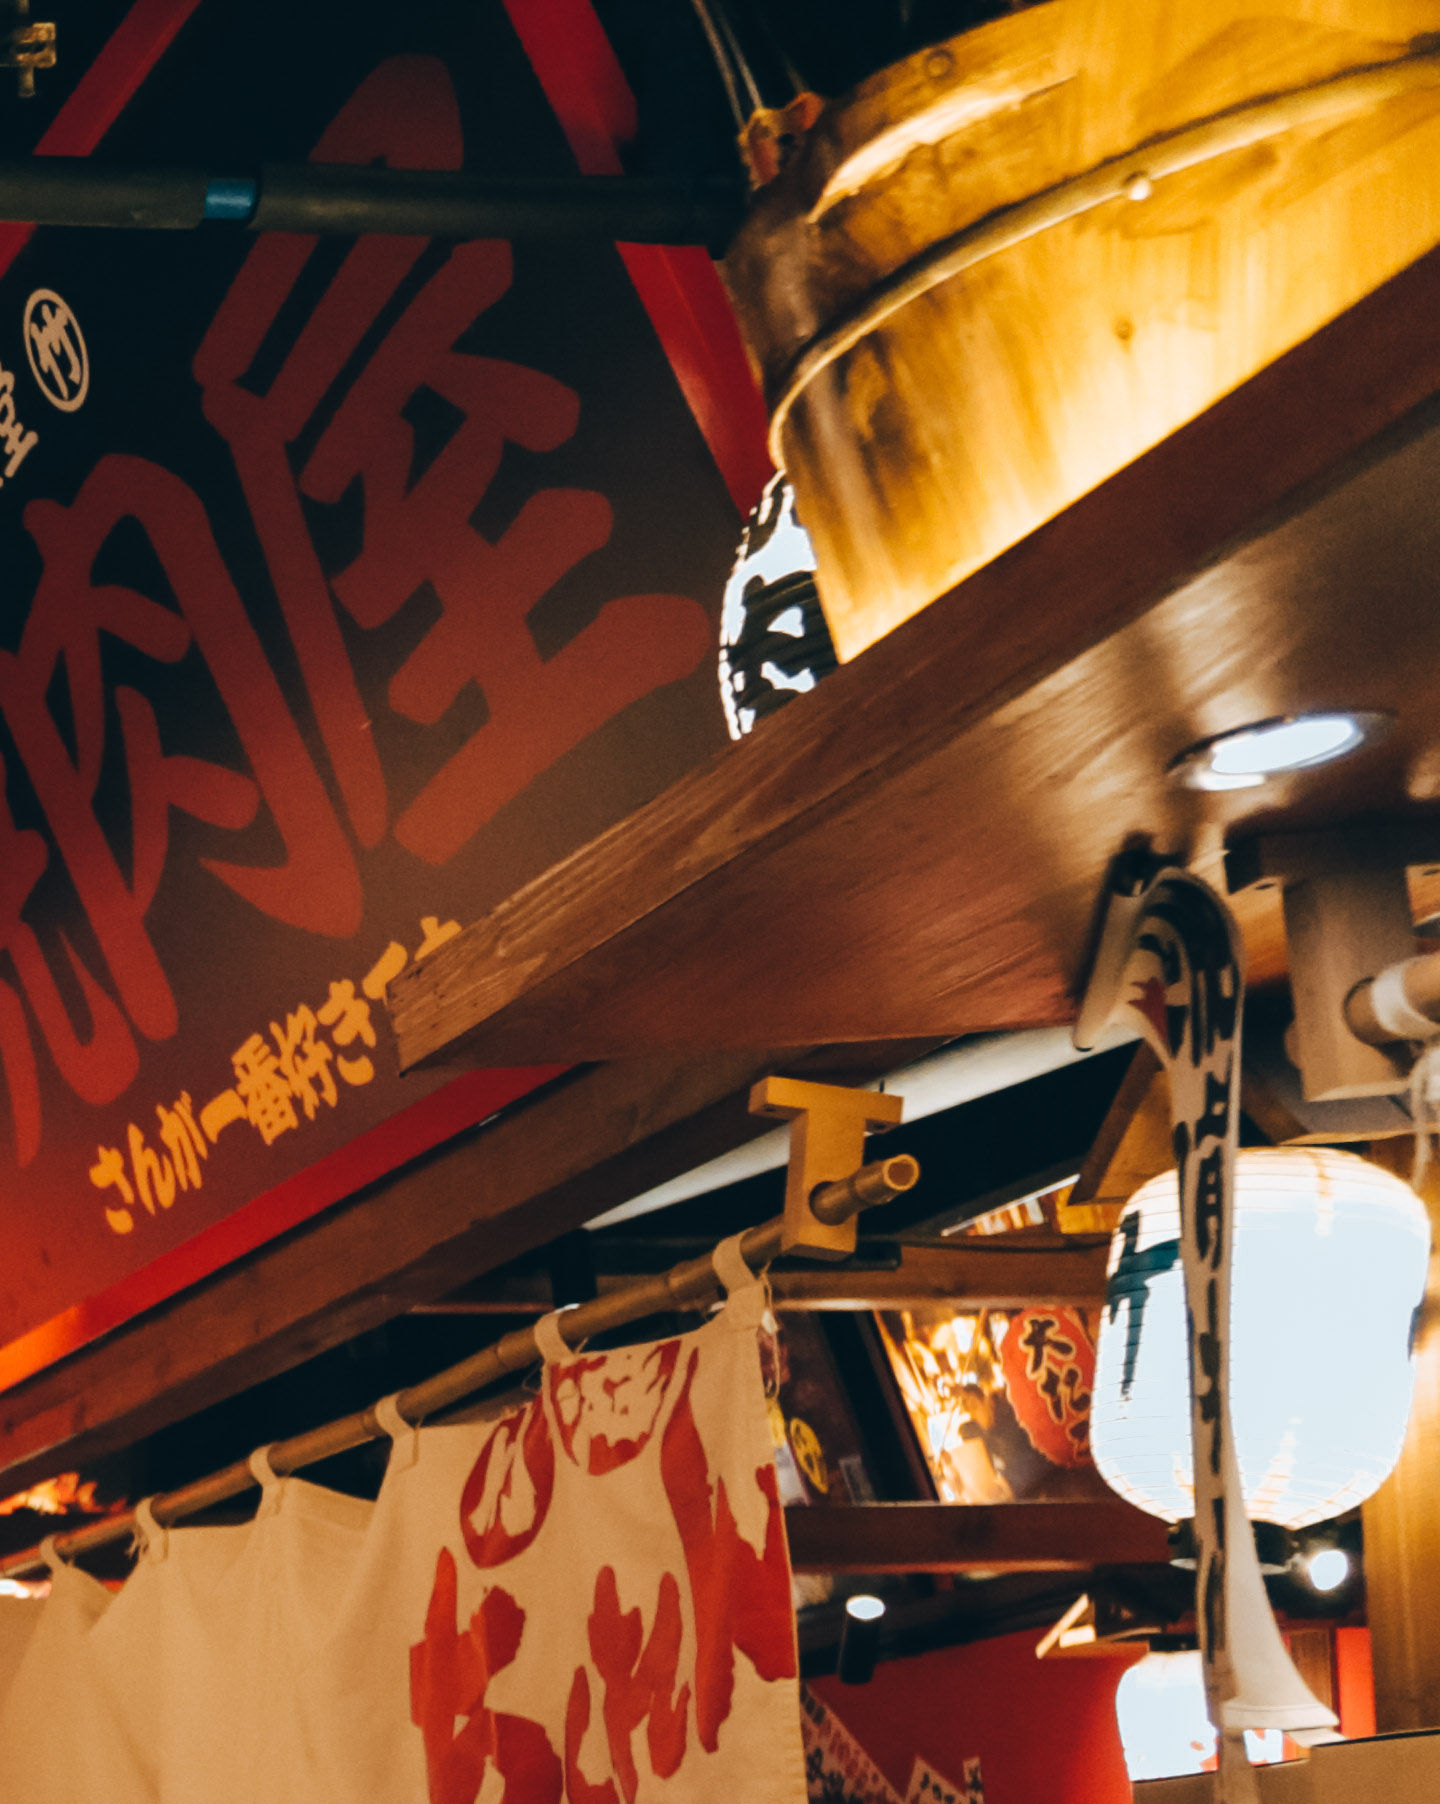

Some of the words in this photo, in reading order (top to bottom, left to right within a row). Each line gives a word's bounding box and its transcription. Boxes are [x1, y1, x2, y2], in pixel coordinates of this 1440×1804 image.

[88, 914, 463, 1235] さんが一番好き
